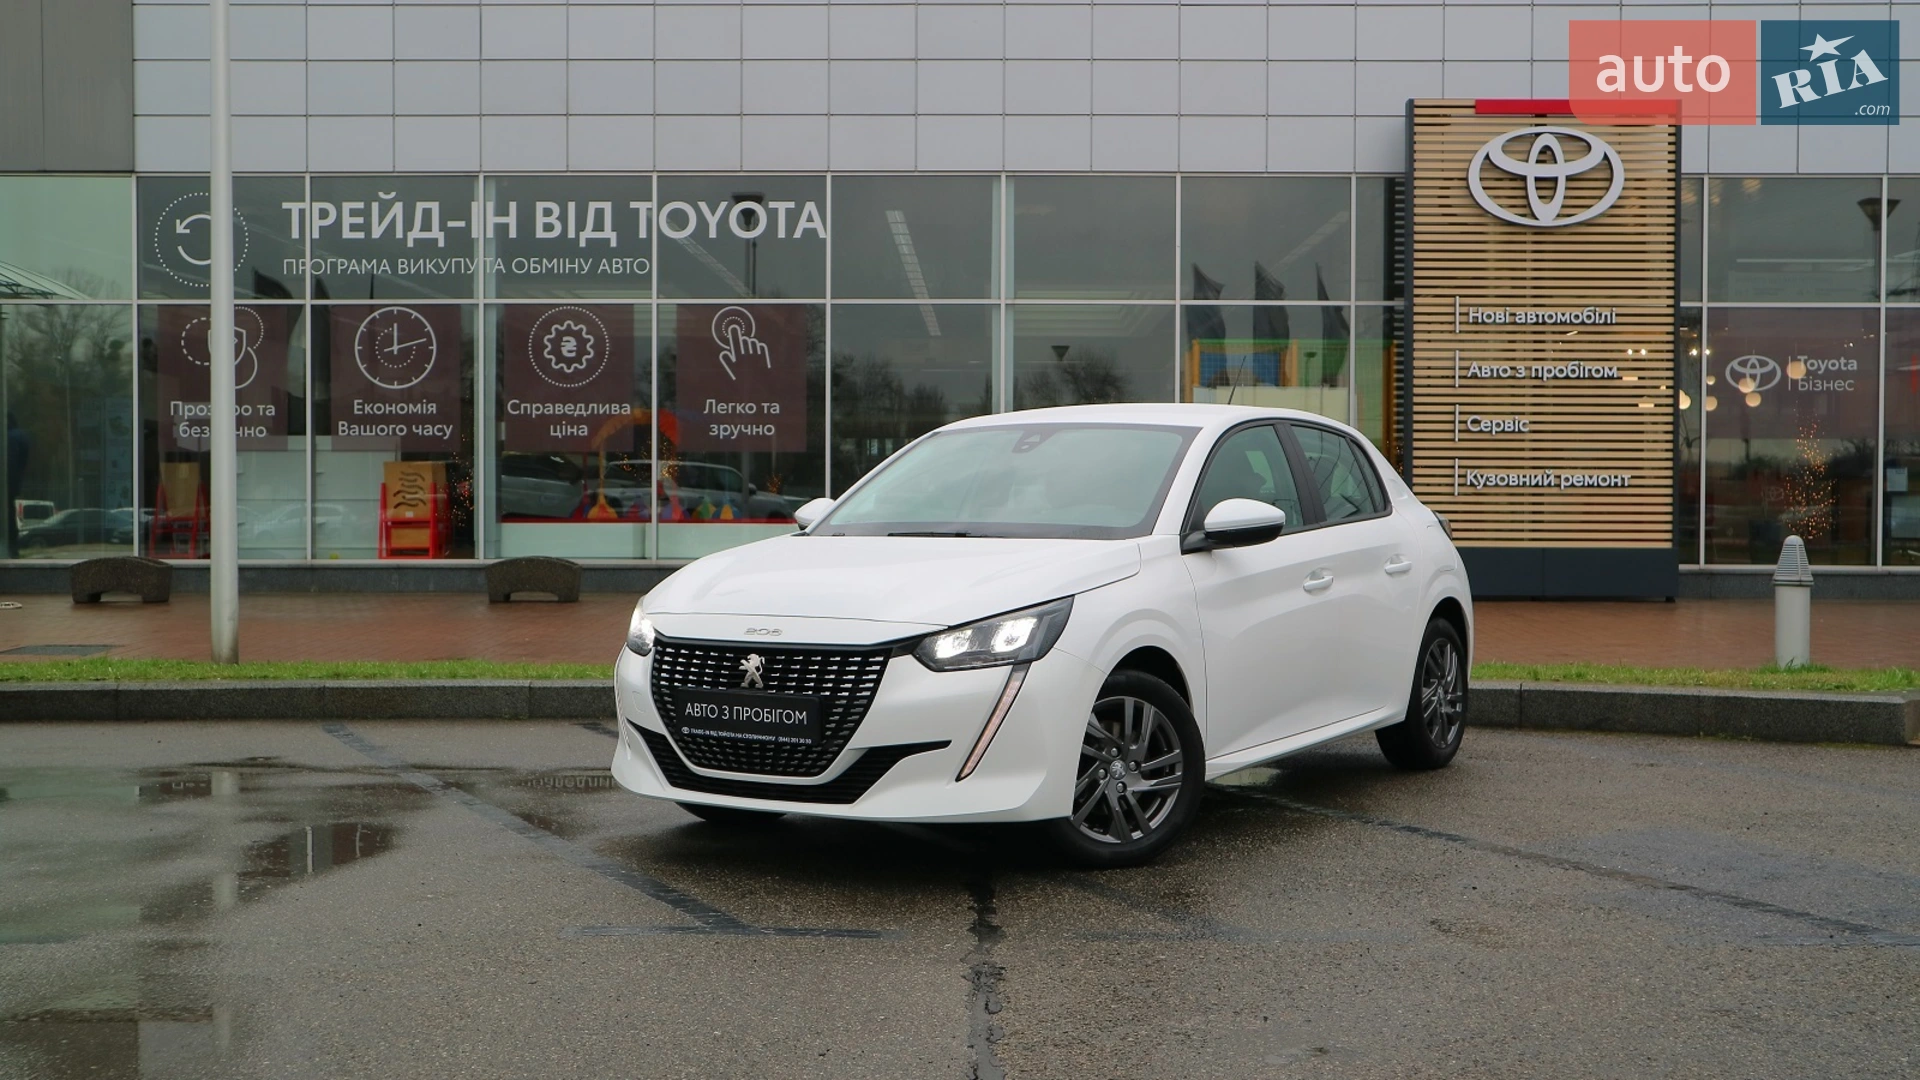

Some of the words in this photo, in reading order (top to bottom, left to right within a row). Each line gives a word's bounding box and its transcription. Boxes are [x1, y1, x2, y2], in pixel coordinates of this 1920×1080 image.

[282, 191, 517, 248] ТРЕЙД-ІН
[535, 201, 617, 248] ВІД
[629, 200, 828, 239] TOYOTA
[283, 258, 391, 275] ПРОГРАМА
[398, 258, 480, 275] ВИКУПУ
[484, 257, 506, 274] ТА
[512, 257, 592, 275] ОБМІНУ
[598, 257, 650, 275] АВТО
[1468, 307, 1510, 324] Нові
[1515, 306, 1617, 325] автомобілі
[1467, 361, 1511, 378] Авто
[1515, 365, 1526, 378] з
[1531, 361, 1619, 381] пробігом
[1797, 356, 1857, 374] Toyota
[1798, 376, 1855, 391] Бізнес
[257, 404, 276, 416] та
[353, 399, 437, 415] Економія
[507, 400, 631, 417] Справедлива
[703, 400, 757, 415] Легко
[762, 403, 780, 414] та
[179, 421, 267, 437] безчно
[338, 420, 407, 436] Вашого
[412, 424, 453, 439] часу
[550, 422, 588, 438] ціна
[709, 424, 775, 439] зручно
[1467, 415, 1530, 435] Сервіс
[1466, 469, 1555, 490] Кузовний
[1560, 474, 1632, 490] ремонт
[685, 702, 718, 718] АВТО
[721, 705, 729, 719] З
[733, 706, 807, 725] ПРОБІГОМ
